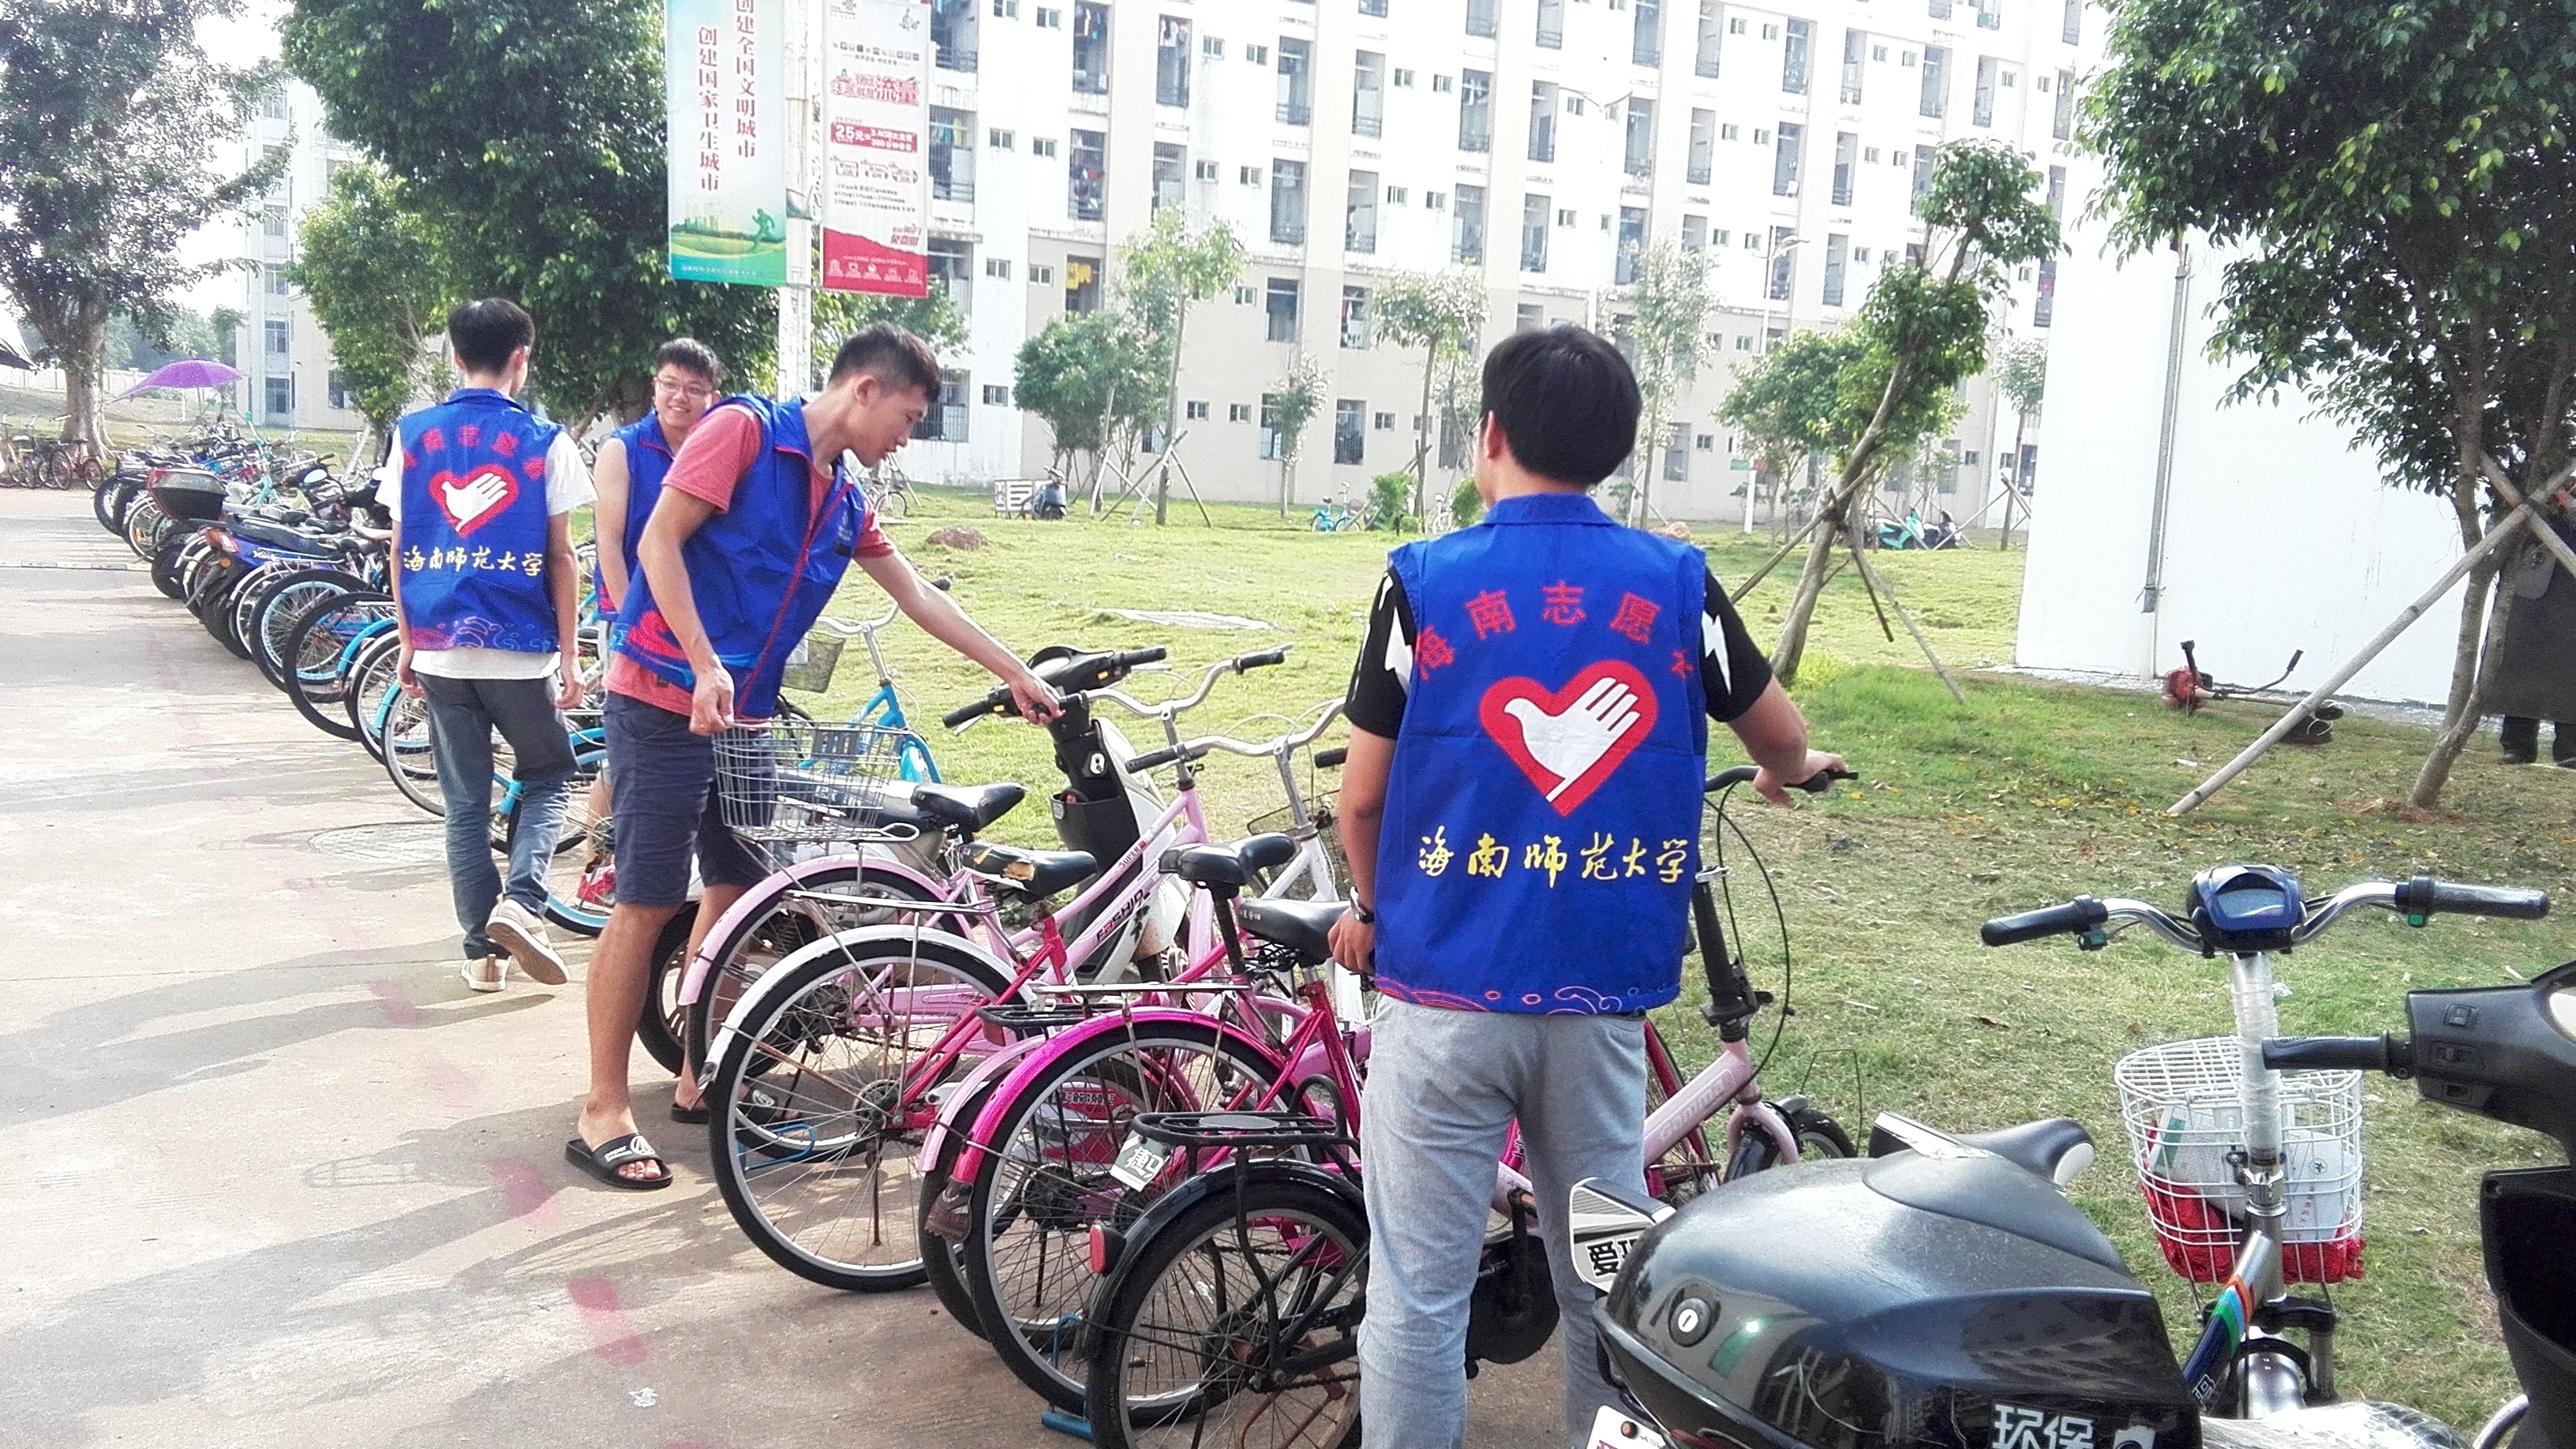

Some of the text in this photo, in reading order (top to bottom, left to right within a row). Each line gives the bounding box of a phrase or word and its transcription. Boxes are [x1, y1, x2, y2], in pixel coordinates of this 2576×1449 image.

[698, 26, 719, 191] 创建国家卫生城市
[736, 0, 755, 157] 创建全国文明城市
[403, 545, 543, 576] 海南师范大学
[1118, 846, 1140, 867] SUPER
[1419, 825, 1688, 888] 海南师范大学
